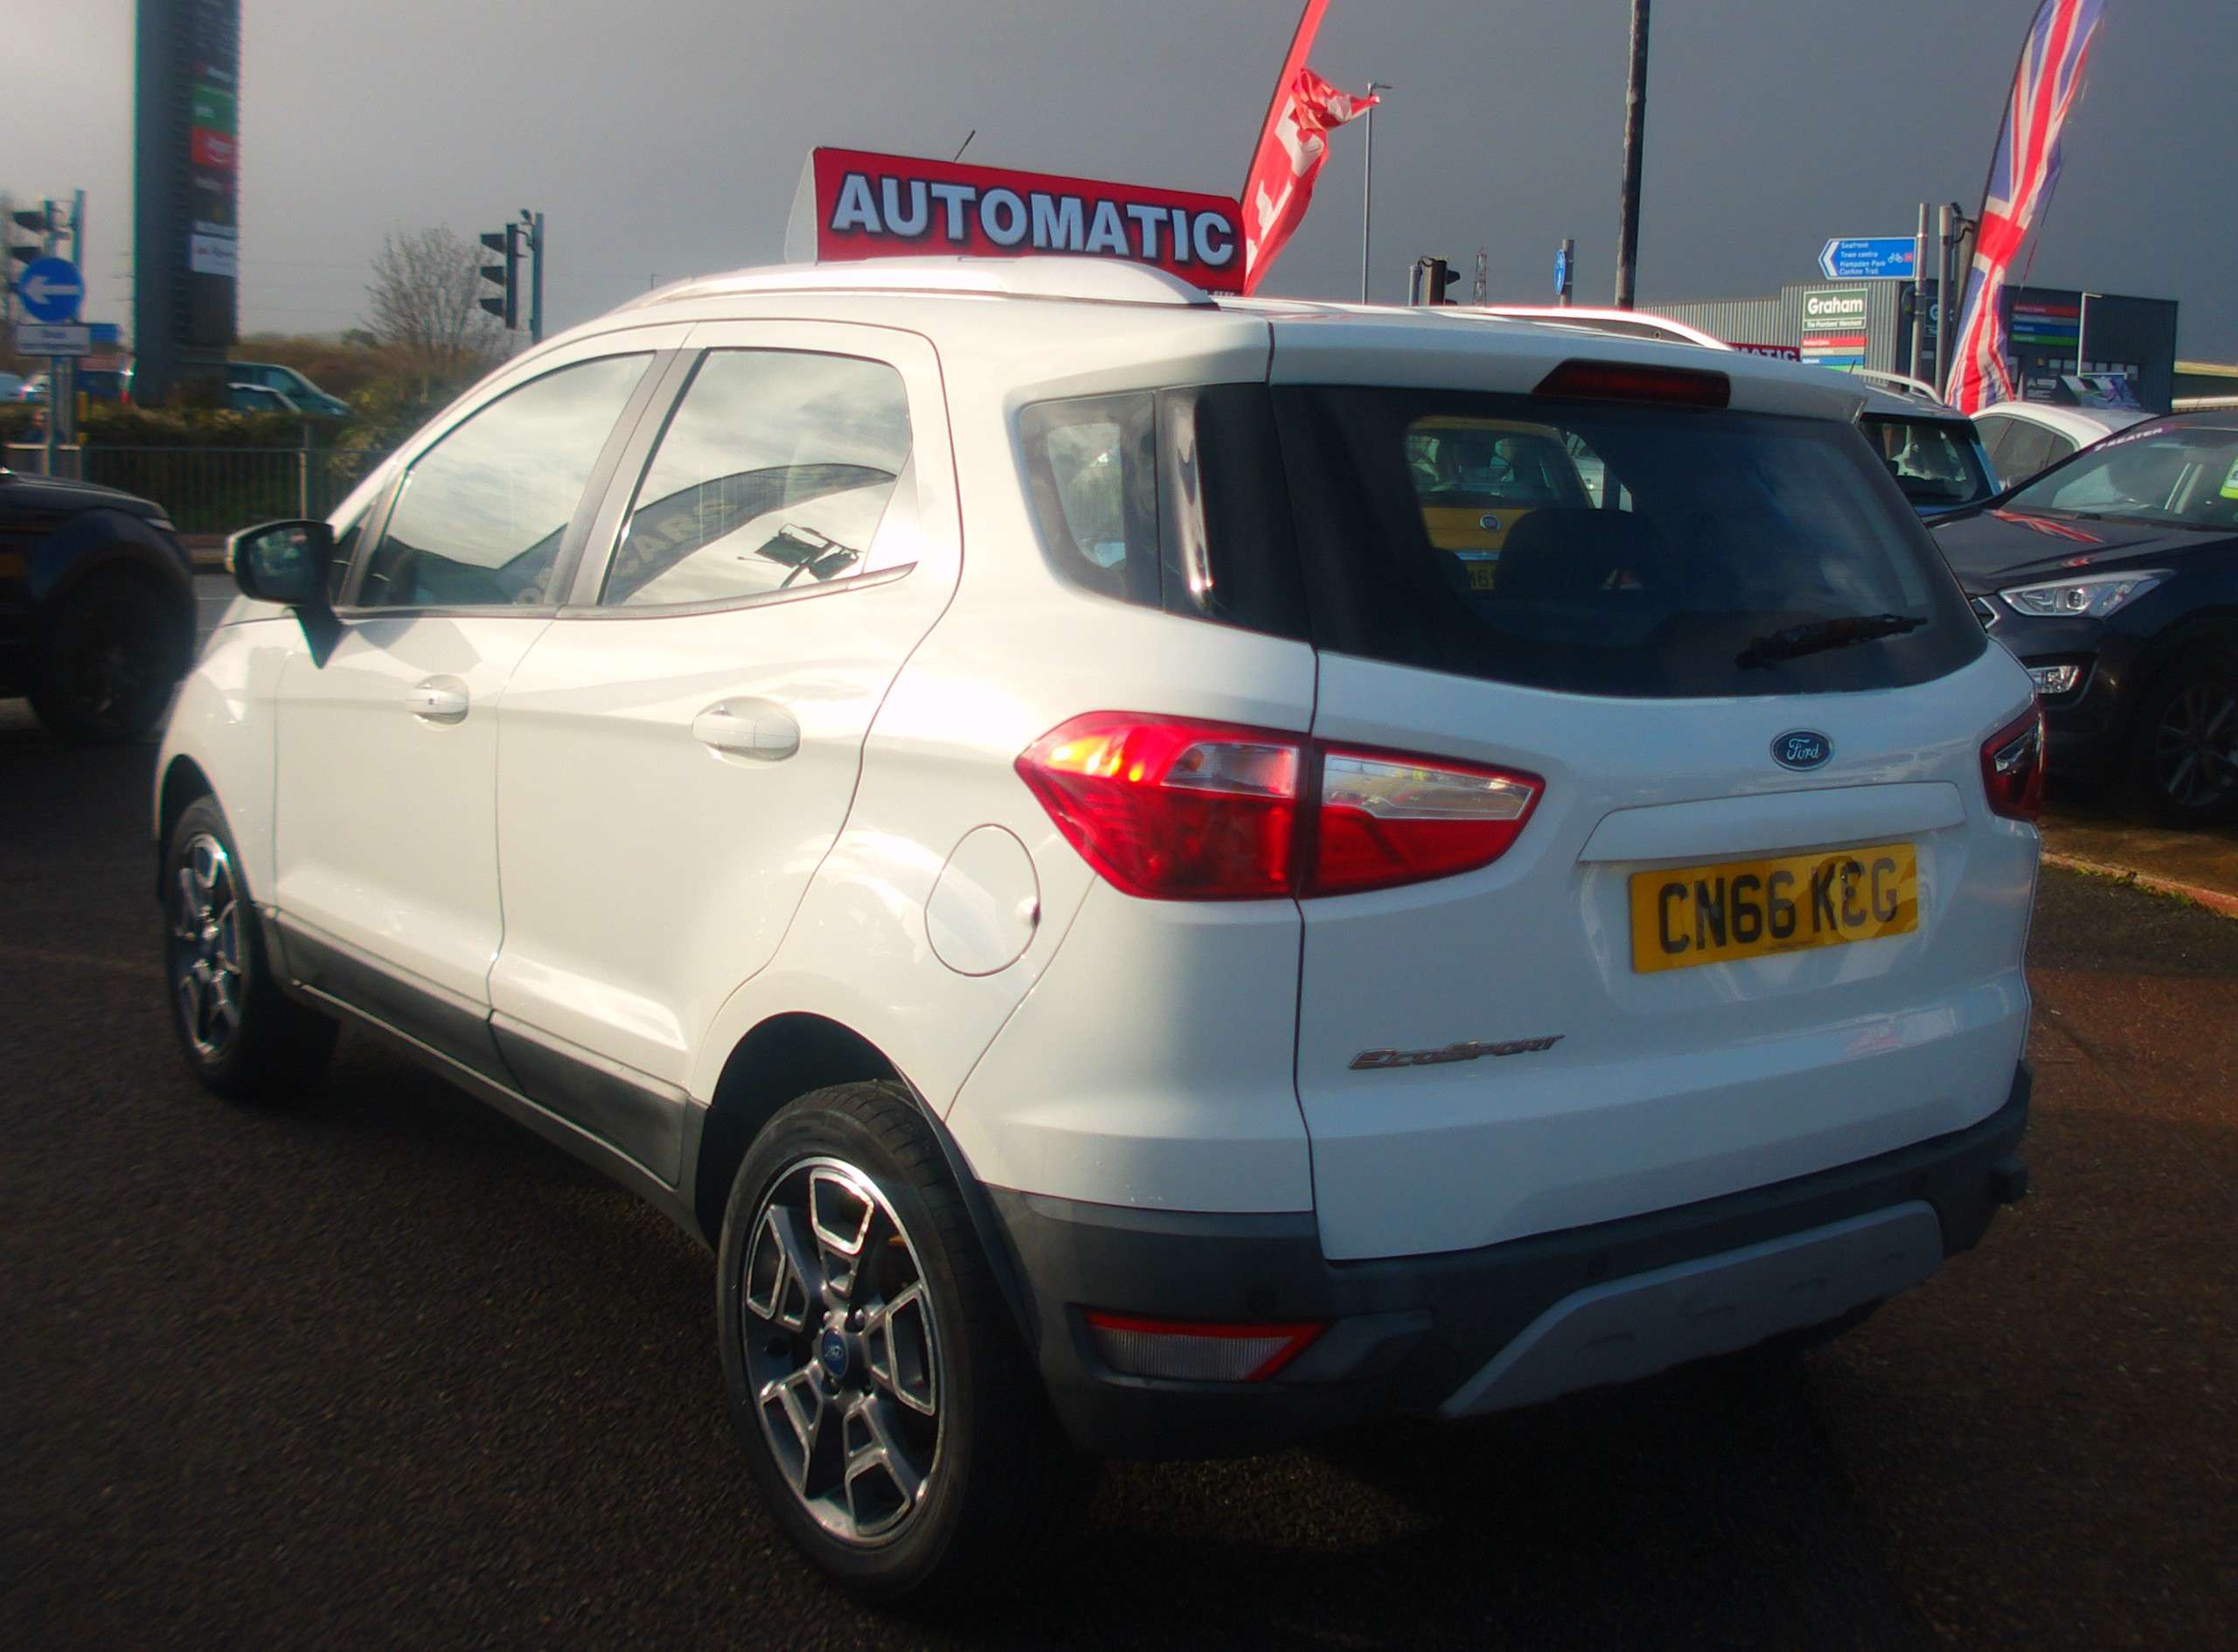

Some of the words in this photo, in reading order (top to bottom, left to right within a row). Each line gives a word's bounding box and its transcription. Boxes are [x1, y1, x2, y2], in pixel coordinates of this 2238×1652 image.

[831, 173, 1234, 266] AUTOMATIC
[1807, 296, 1863, 316] Graham
[1785, 738, 1820, 761] Ford
[1658, 869, 1797, 954] CN66
